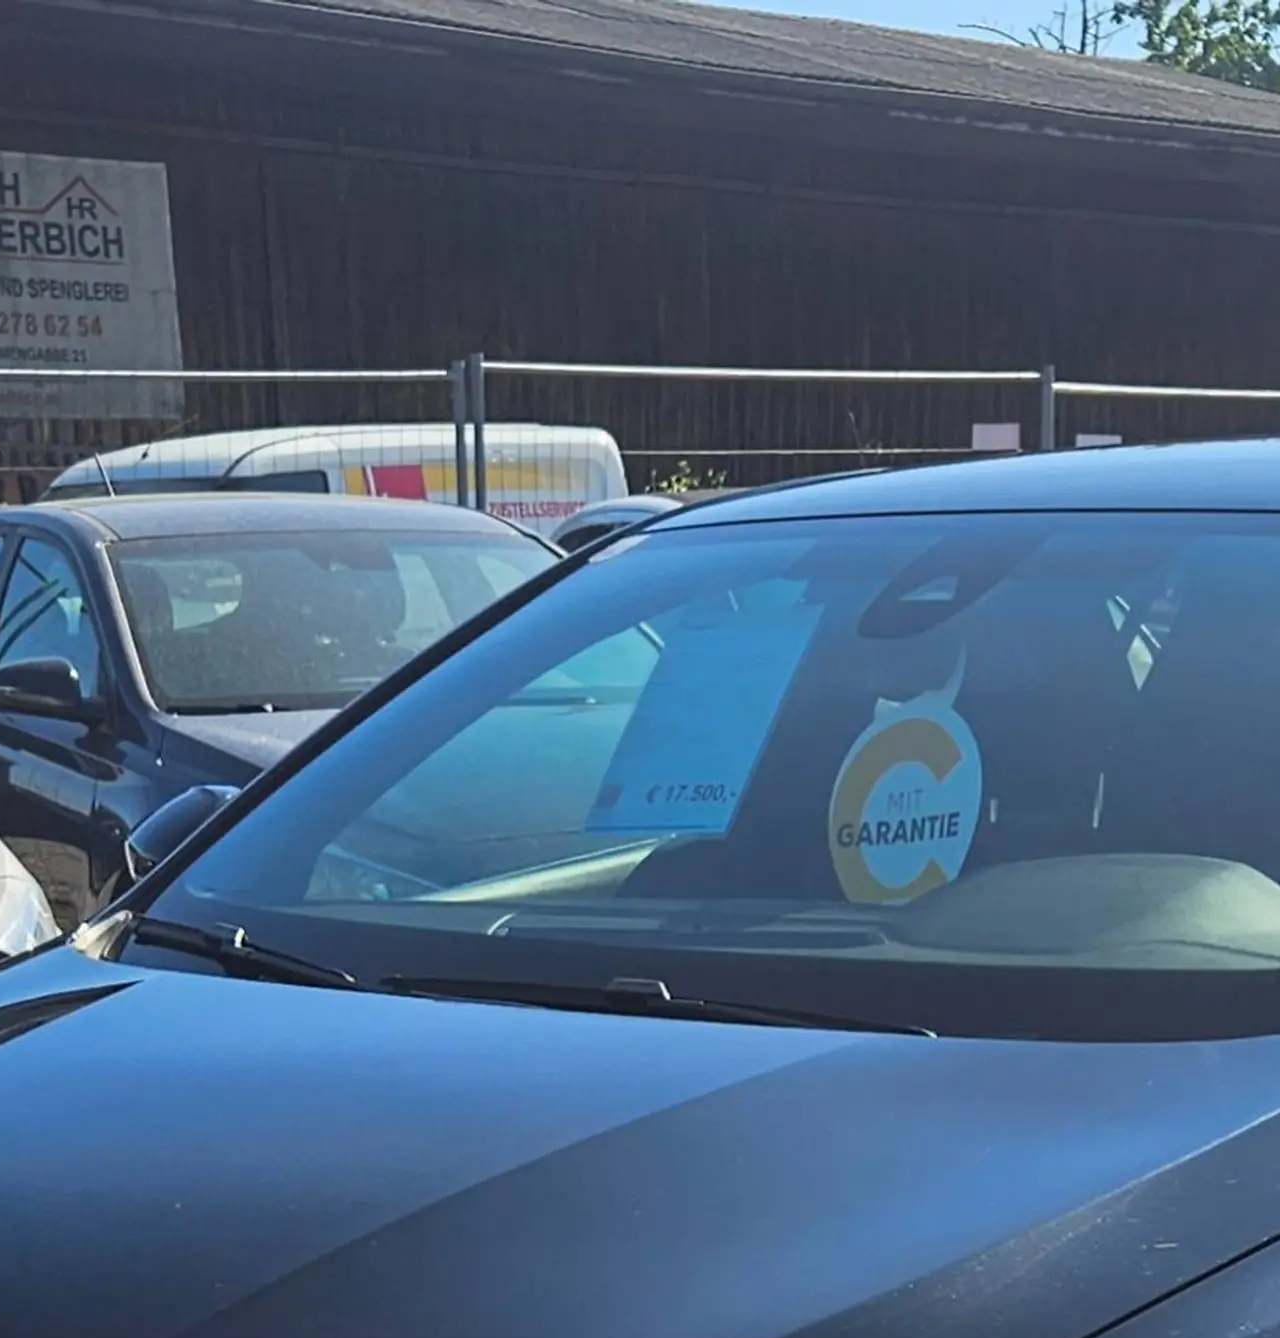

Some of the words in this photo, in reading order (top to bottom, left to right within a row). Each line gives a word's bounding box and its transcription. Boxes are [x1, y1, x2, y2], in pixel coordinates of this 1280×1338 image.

[66, 196, 98, 221] HR
[26, 277, 129, 302] SPENGLEREI
[77, 314, 102, 339] 54
[645, 784, 660, 804] €
[664, 783, 737, 804] 17.500,-
[886, 789, 924, 815] MIT
[836, 812, 961, 848] GARANTIE
